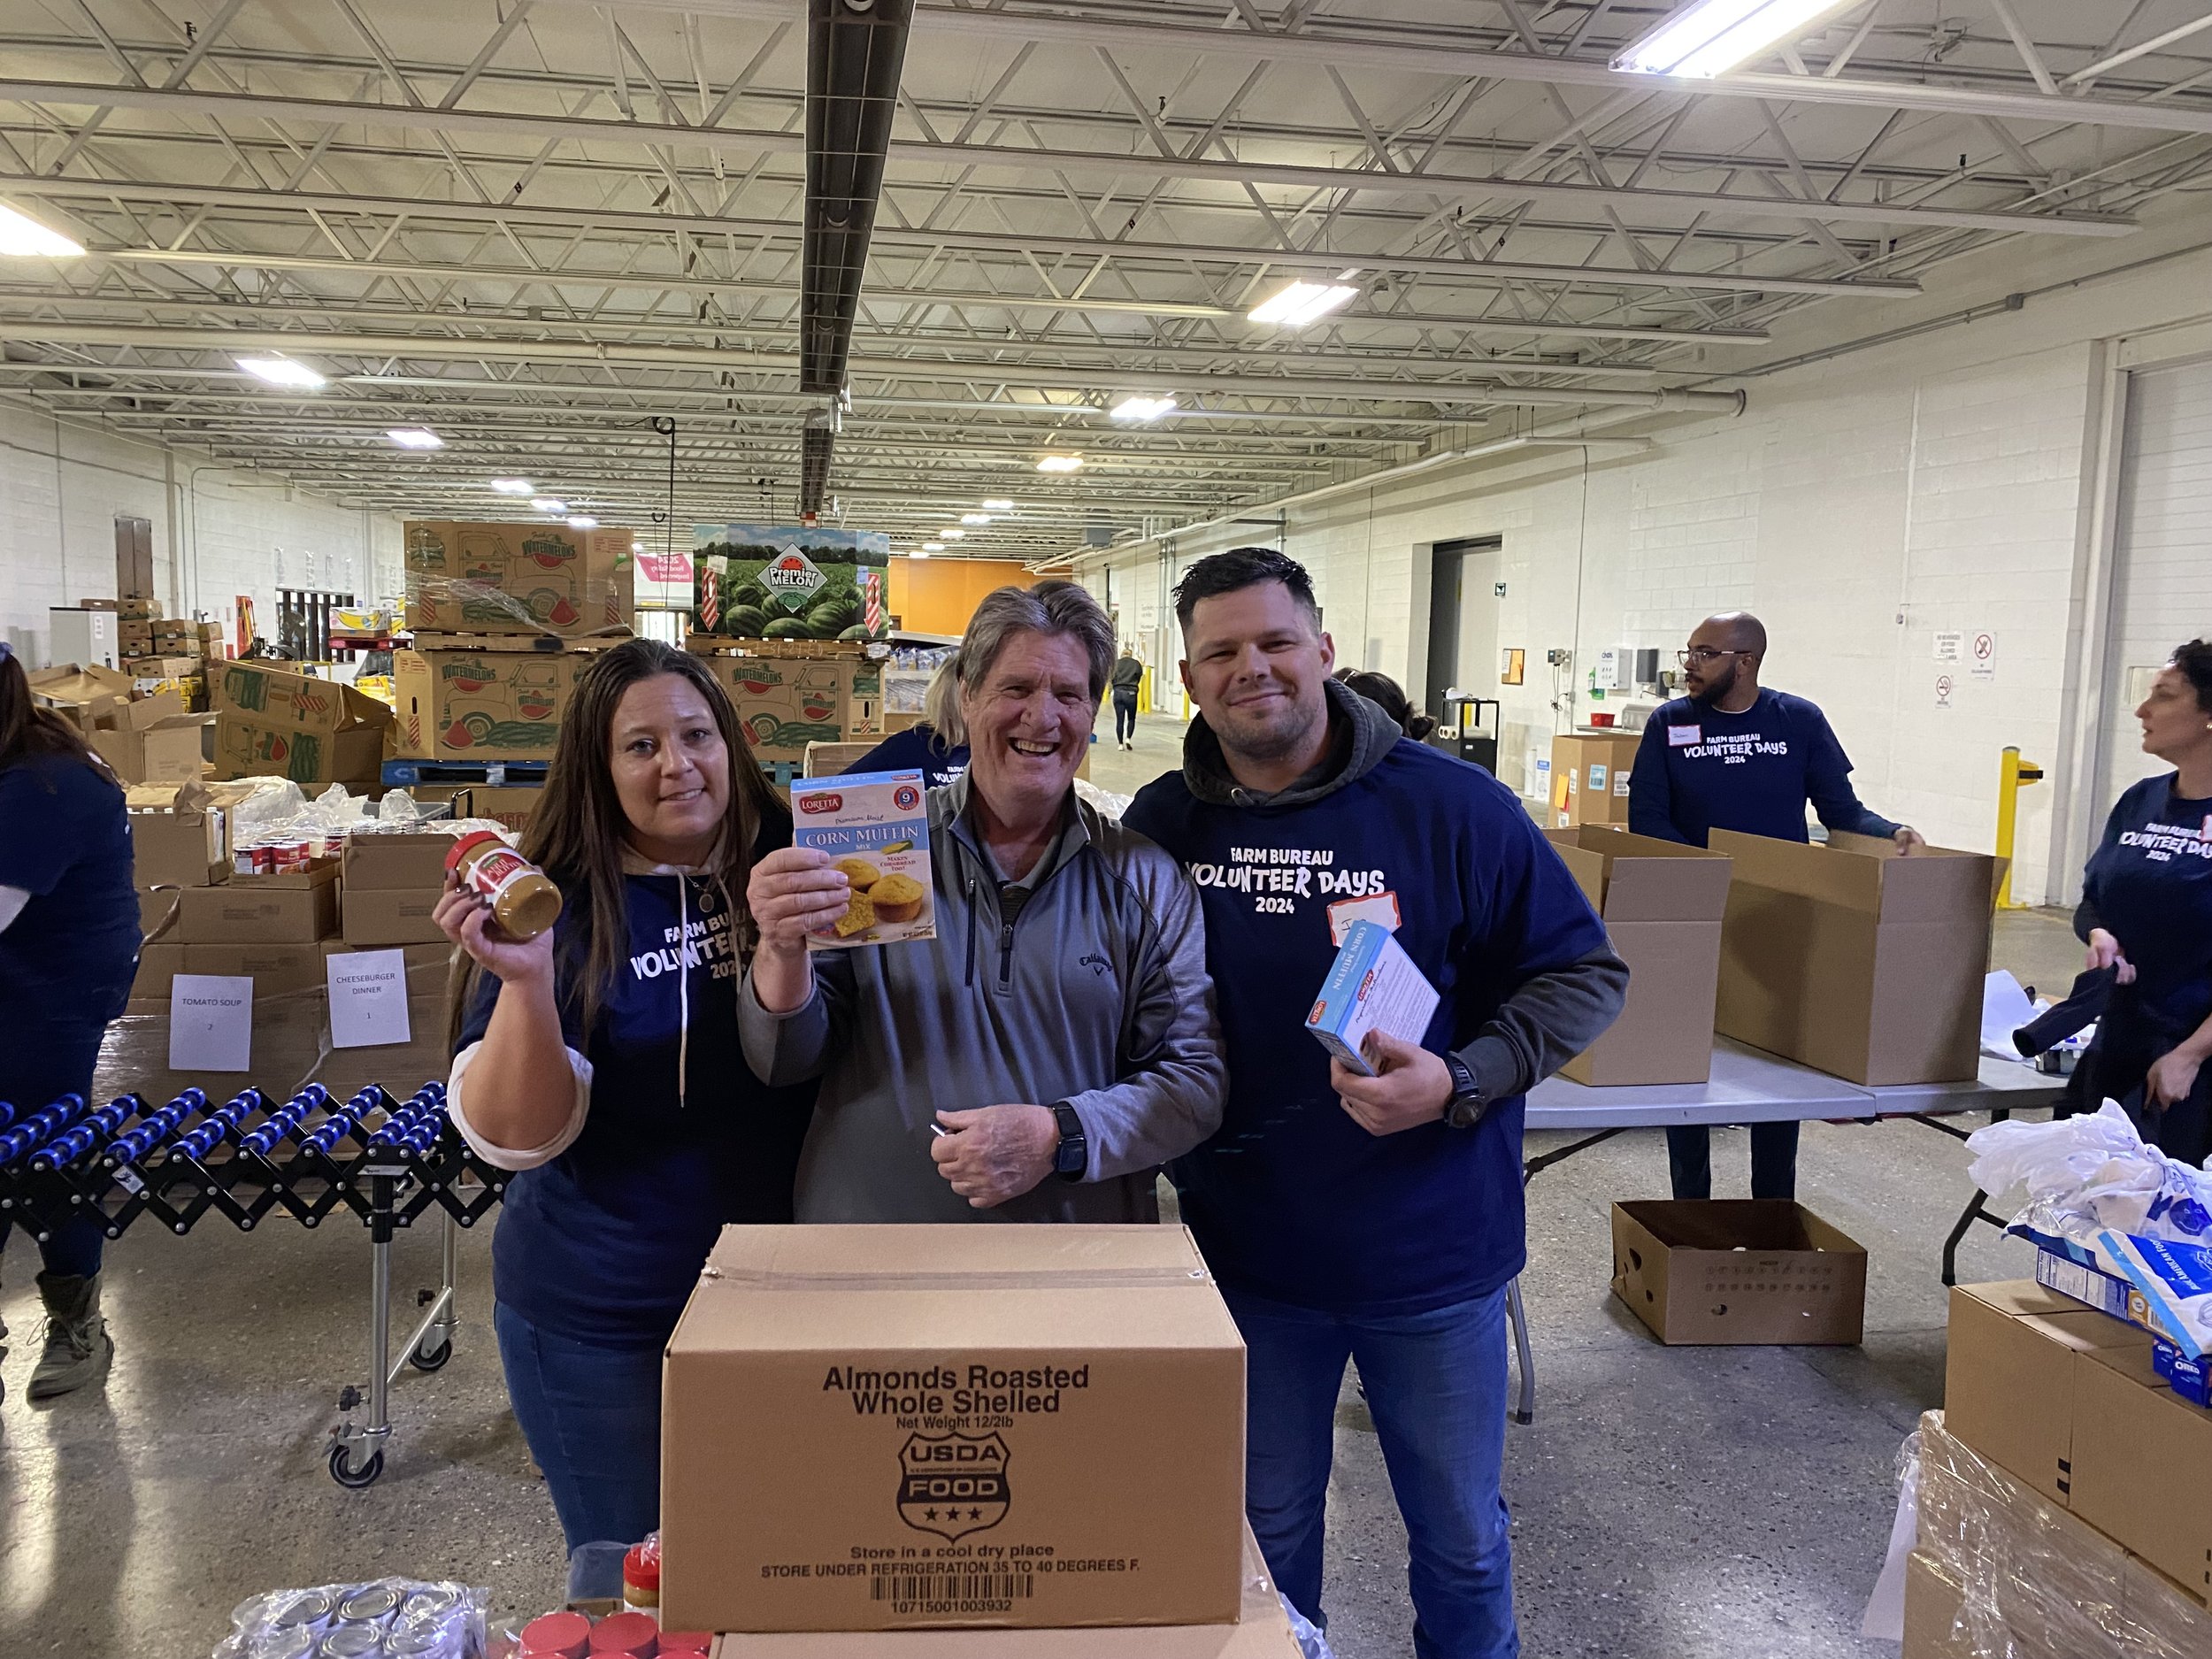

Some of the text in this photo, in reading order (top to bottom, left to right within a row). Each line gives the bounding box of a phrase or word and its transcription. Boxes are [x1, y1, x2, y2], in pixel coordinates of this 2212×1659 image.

[522, 540, 576, 558] WATERMELONS
[769, 567, 818, 580] Premier
[771, 576, 815, 588] MELON
[444, 664, 496, 680] WATERMELONS
[733, 667, 783, 684] WATERMELONS
[1707, 733, 1761, 744] FARM BUREAU
[1684, 741, 1788, 758] VOLUNTEER DAYS
[801, 797, 839, 810] LORETTA
[902, 793, 910, 803] 9
[805, 826, 919, 847] CORN MUFFIN
[1231, 847, 1333, 865] FARM BUREAU
[1185, 861, 1385, 899] VOLUNTEER DAYS
[1255, 896, 1294, 914] 2024
[664, 920, 708, 943] FARM
[1352, 926, 1367, 952] CORN
[335, 972, 396, 984] CHEESEBURGER
[1333, 954, 1356, 991] MUFFIN
[351, 986, 382, 995] DINNER
[181, 998, 219, 1007] TOMATO
[2150, 1239, 2188, 1280] AMERICAN FOO
[2175, 1361, 2200, 1375] OREO
[823, 1363, 1089, 1391] Almonds Roasted
[852, 1388, 1060, 1415] Whole Shelled
[896, 1415, 1014, 1431] Net Weight 12/2lb
[910, 1445, 1002, 1462] USDA
[909, 1479, 999, 1497] FOOD
[850, 1545, 1055, 1560] Store in a cool dry place
[761, 1559, 1141, 1578] STORE UNDER REFRIGERATION 35 TO 40 DEGREES F.
[891, 1600, 1012, 1615] 10715001003932
